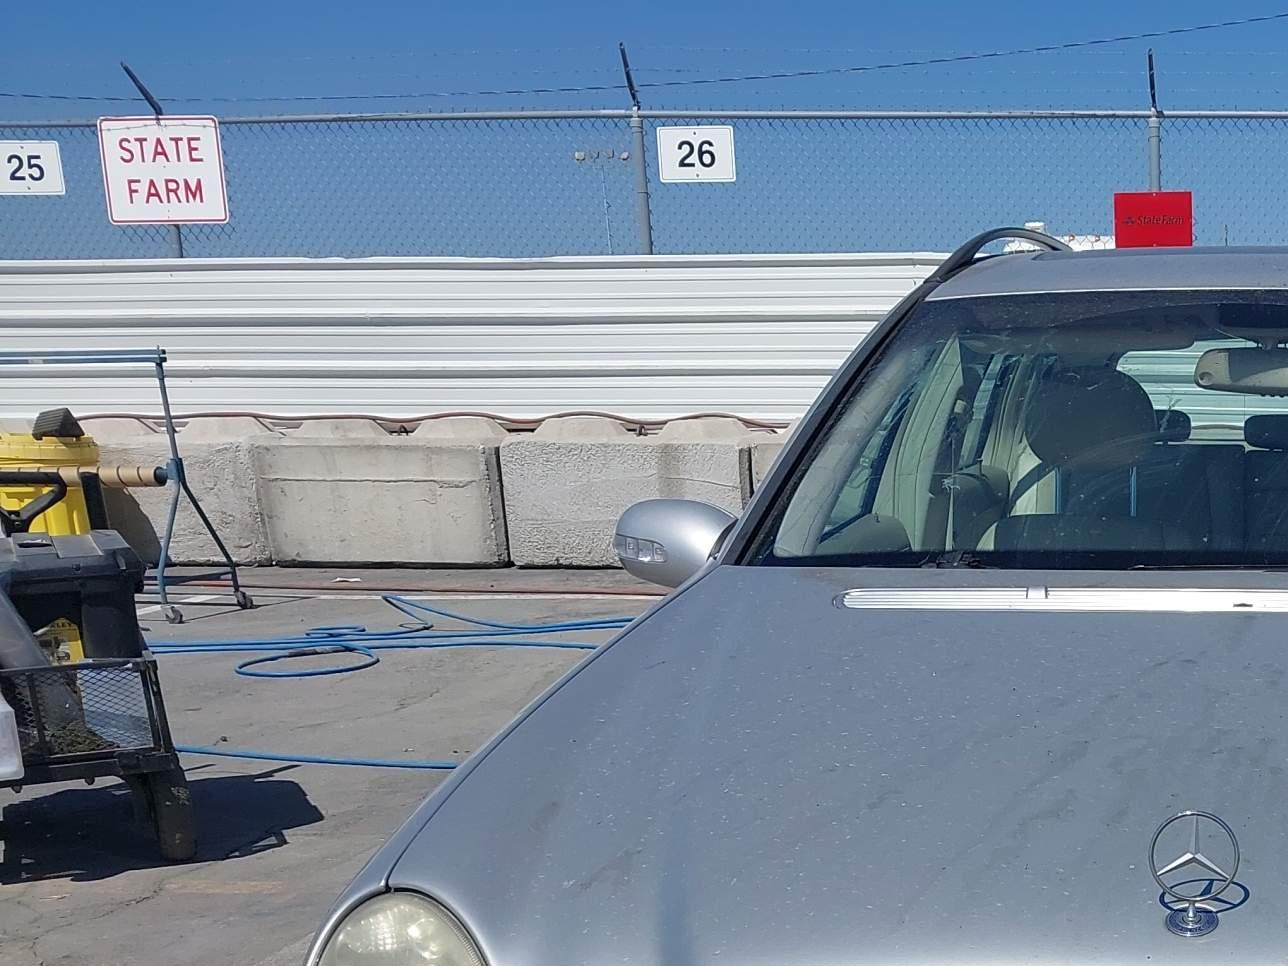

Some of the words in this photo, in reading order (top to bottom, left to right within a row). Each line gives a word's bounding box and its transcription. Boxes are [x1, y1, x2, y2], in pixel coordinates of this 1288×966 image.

[118, 137, 204, 164] STATE
[677, 140, 716, 168] 26
[6, 154, 45, 182] 25
[126, 178, 204, 204] FARM
